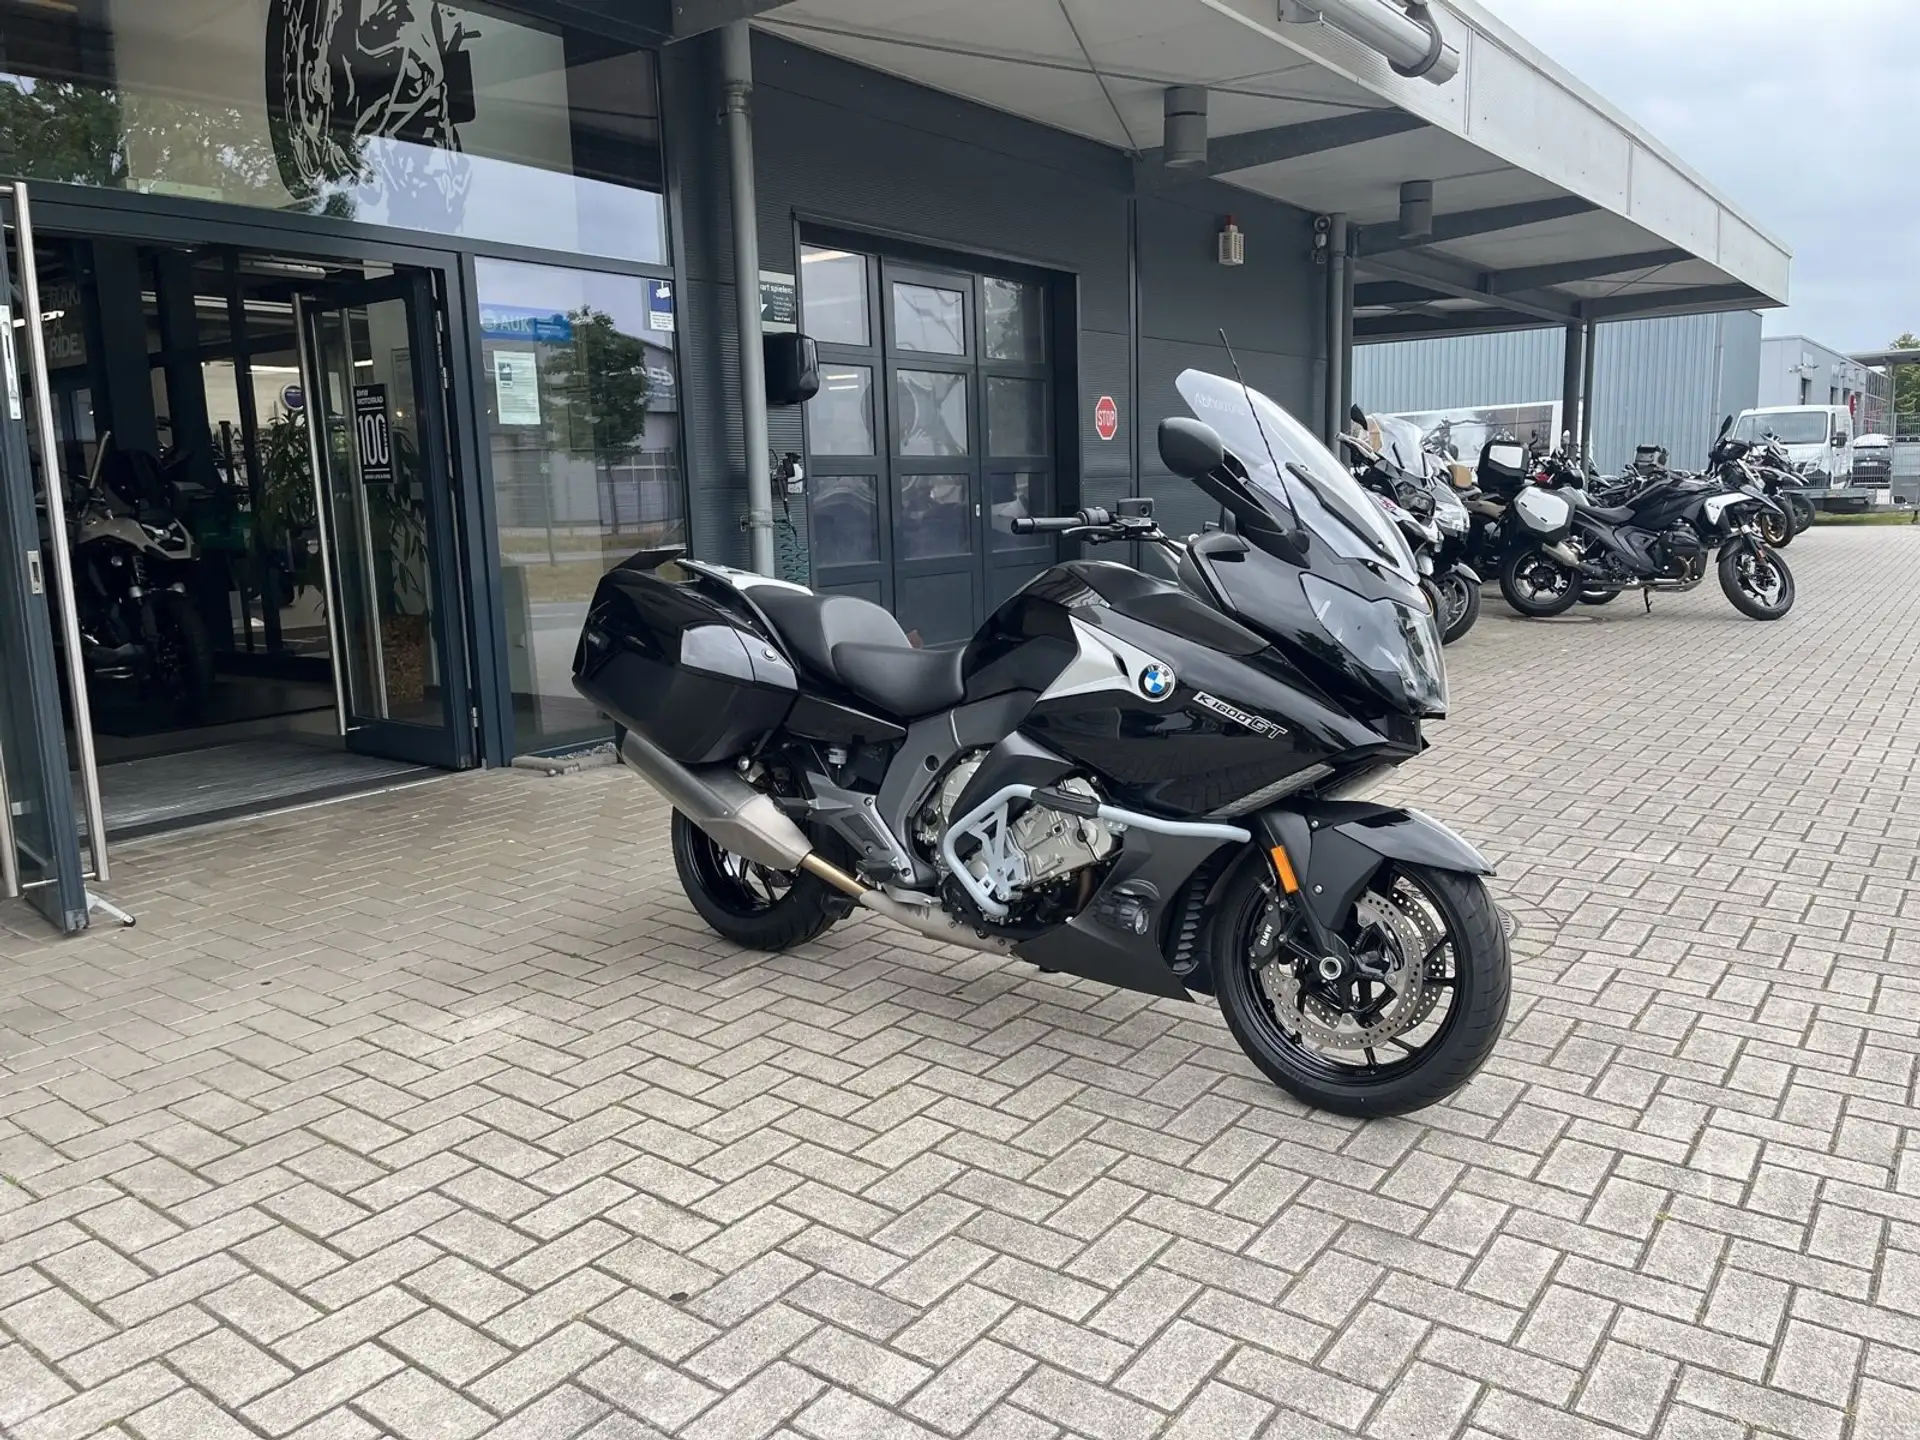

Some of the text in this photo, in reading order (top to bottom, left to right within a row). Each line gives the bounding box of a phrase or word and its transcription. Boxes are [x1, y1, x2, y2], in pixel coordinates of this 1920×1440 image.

[1098, 410, 1115, 426] STOP
[358, 413, 389, 465] 100
[1260, 924, 1273, 947] BMW
